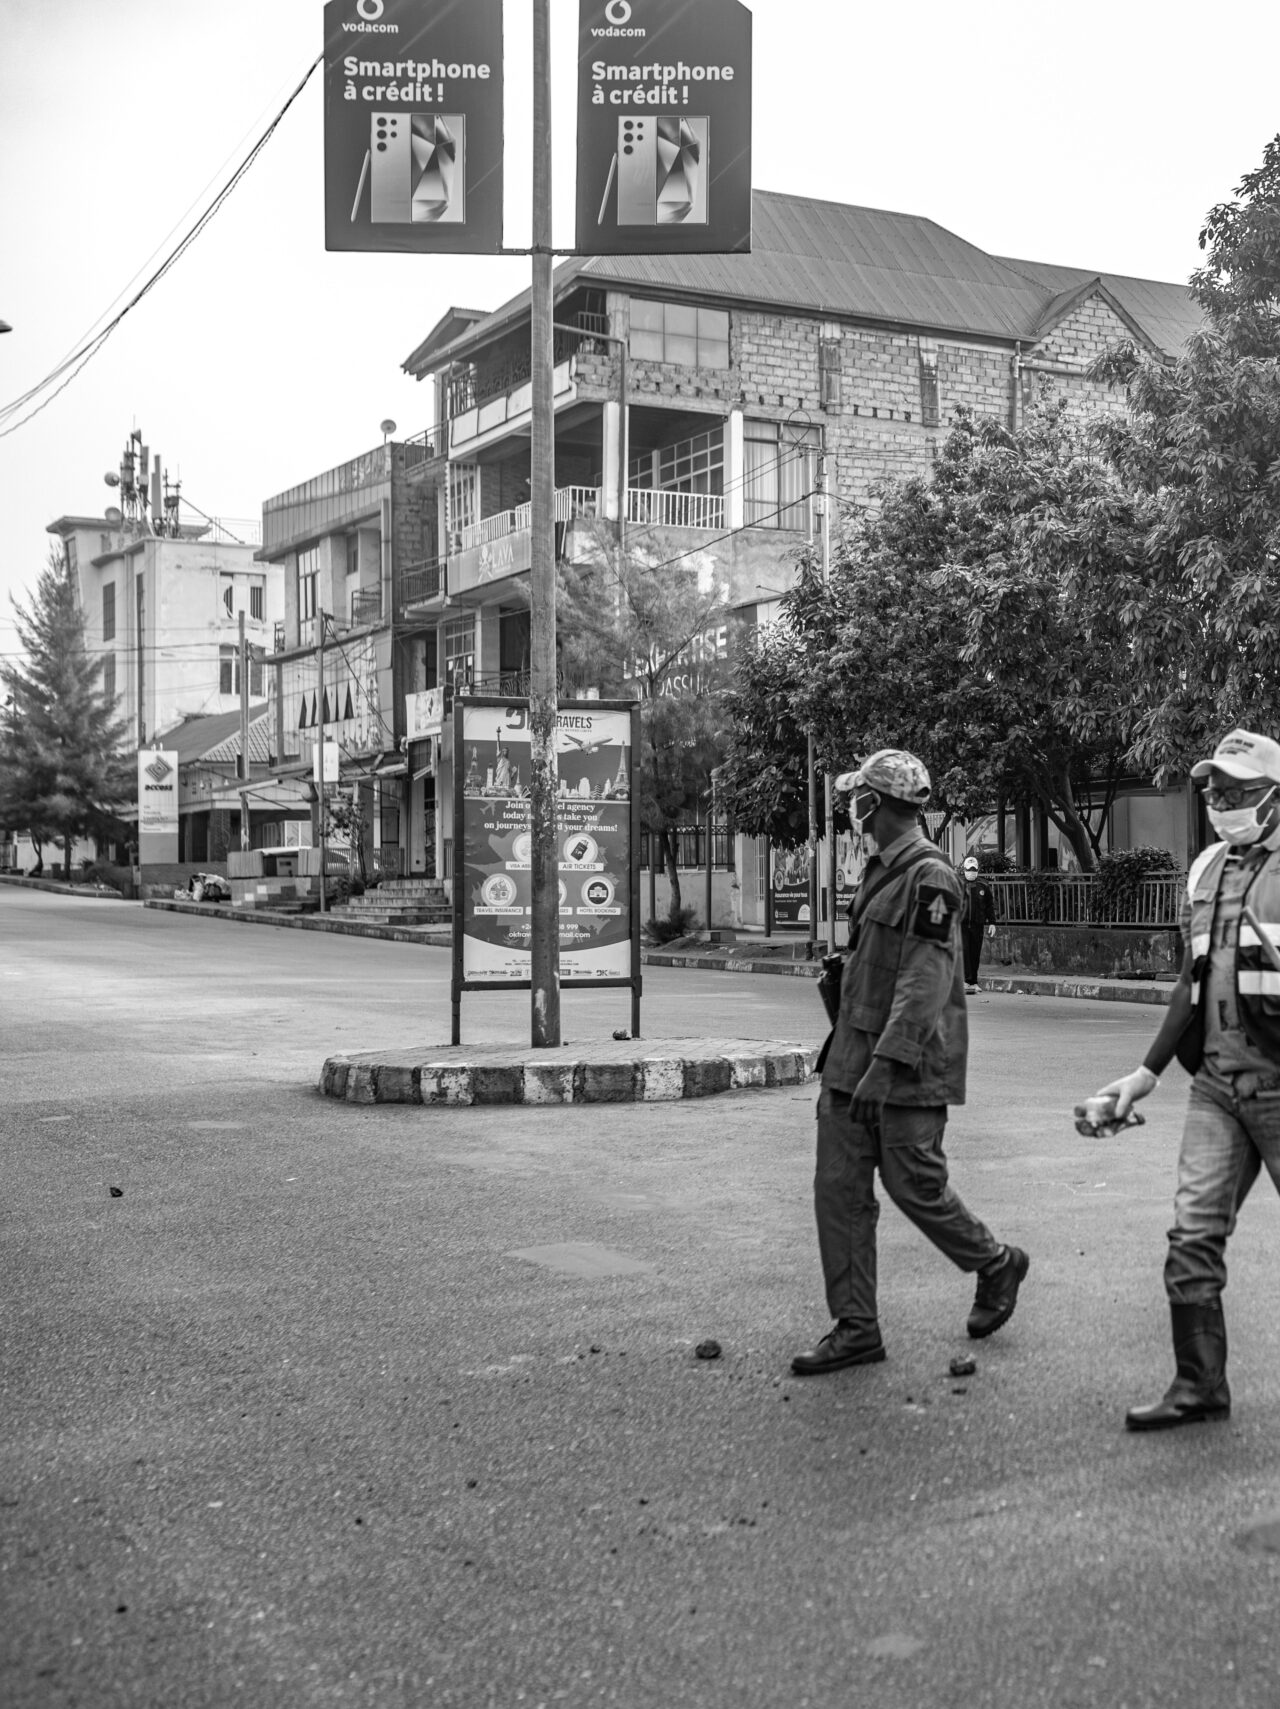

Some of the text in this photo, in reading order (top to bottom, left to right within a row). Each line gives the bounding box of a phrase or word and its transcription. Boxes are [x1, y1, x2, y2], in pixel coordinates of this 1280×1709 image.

[342, 21, 399, 33] vodacom
[591, 26, 646, 37] vodacom
[343, 56, 491, 82] Smartphone
[591, 61, 735, 85] Smartphone
[343, 79, 357, 101] à
[362, 80, 433, 102] crédit
[591, 84, 605, 104] à
[609, 84, 678, 104] crédit
[556, 715, 593, 729] RAVELS
[505, 800, 524, 809] Join
[566, 803, 596, 813] agency
[503, 811, 526, 821] today
[563, 812, 582, 821] take
[582, 814, 598, 823] you
[495, 820, 532, 831] journeys
[564, 824, 584, 833] your
[584, 823, 618, 832] dreams!
